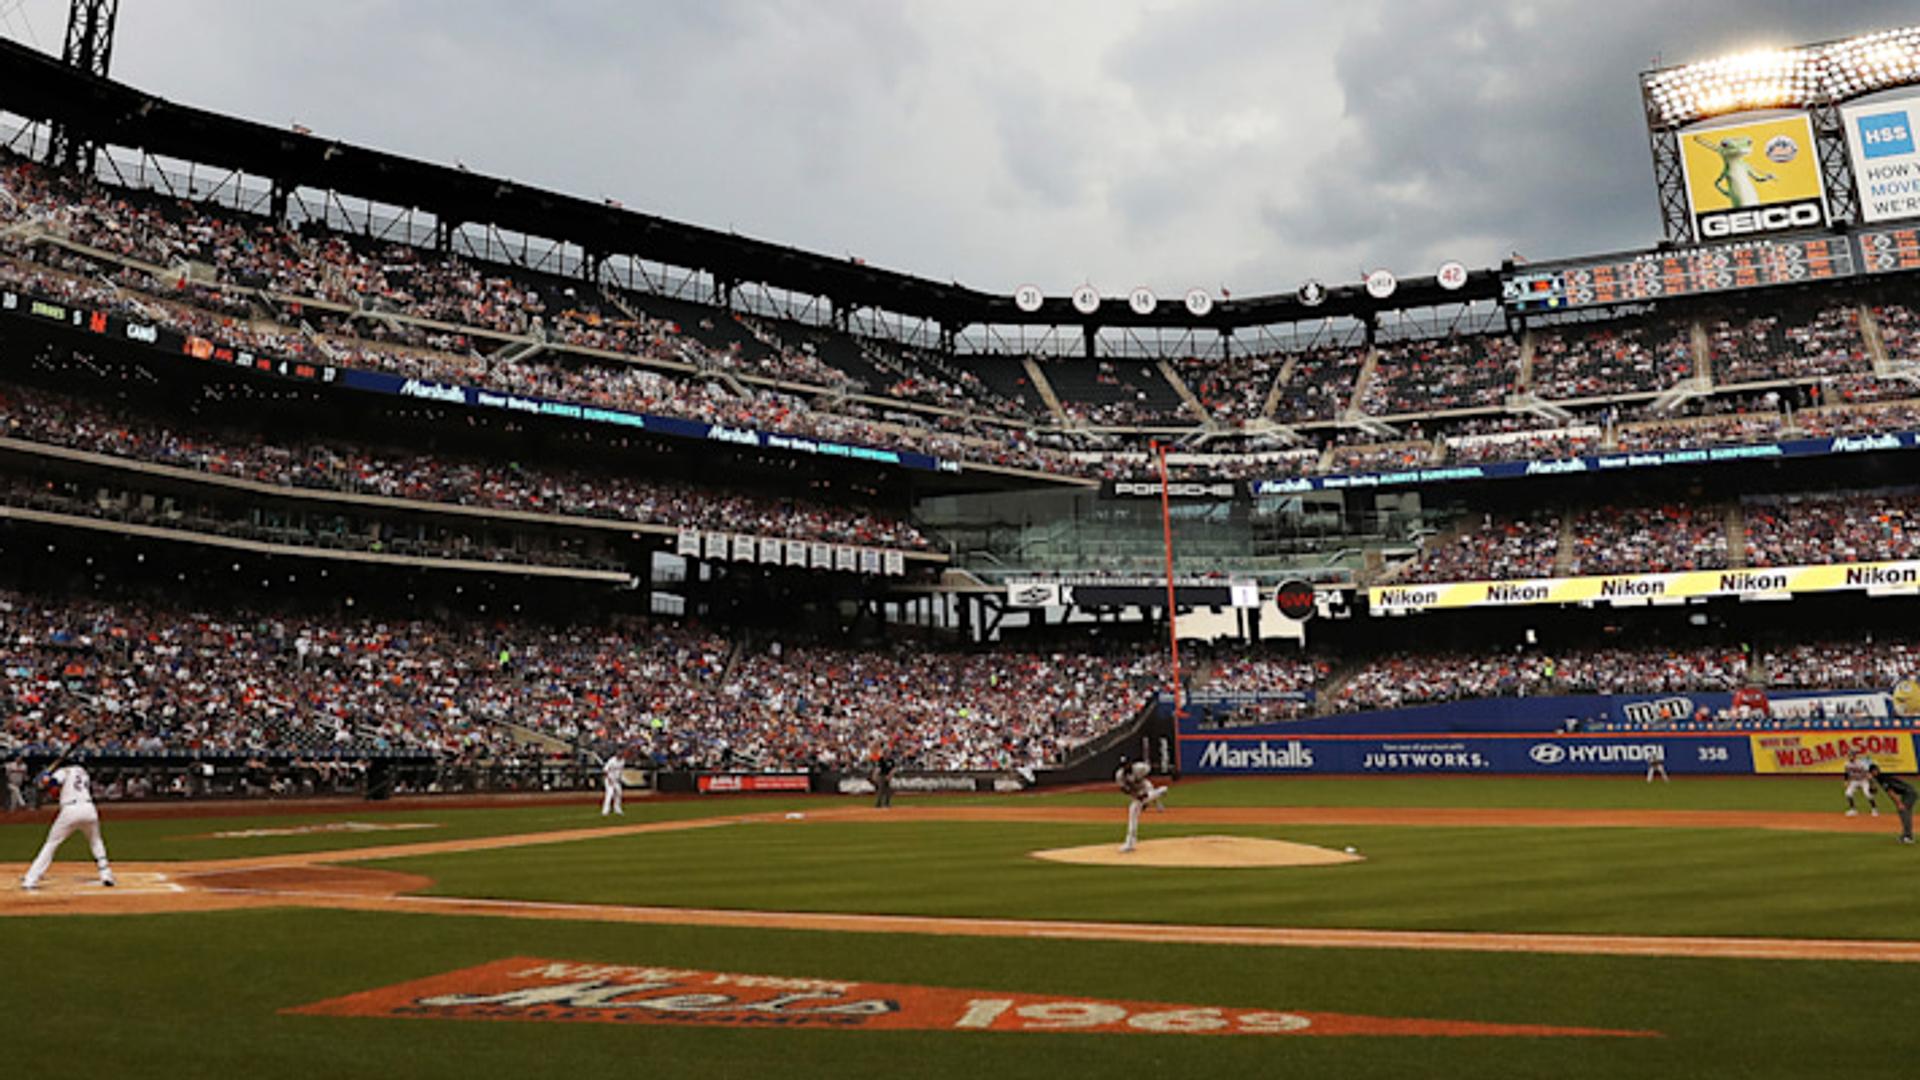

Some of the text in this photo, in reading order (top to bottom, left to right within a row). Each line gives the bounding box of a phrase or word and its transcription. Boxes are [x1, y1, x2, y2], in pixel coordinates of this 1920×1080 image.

[1865, 125, 1908, 145] HSS
[1867, 165, 1910, 182] HOW
[1701, 202, 1820, 238] GEICO
[1442, 267, 1461, 283] 42
[1831, 433, 1901, 453] Marshalls
[1526, 456, 1587, 475] Marshalls
[1720, 572, 1787, 591] Nikon
[1846, 566, 1917, 586] Nikon
[1379, 588, 1438, 607] Nikon
[1487, 582, 1549, 602] Nikon
[1601, 580, 1665, 598] Nikon
[1199, 741, 1314, 768] Marshalls
[1569, 744, 1664, 762] HYUNDAI
[1698, 747, 1728, 761] 358
[953, 998, 1312, 1031] 1969
